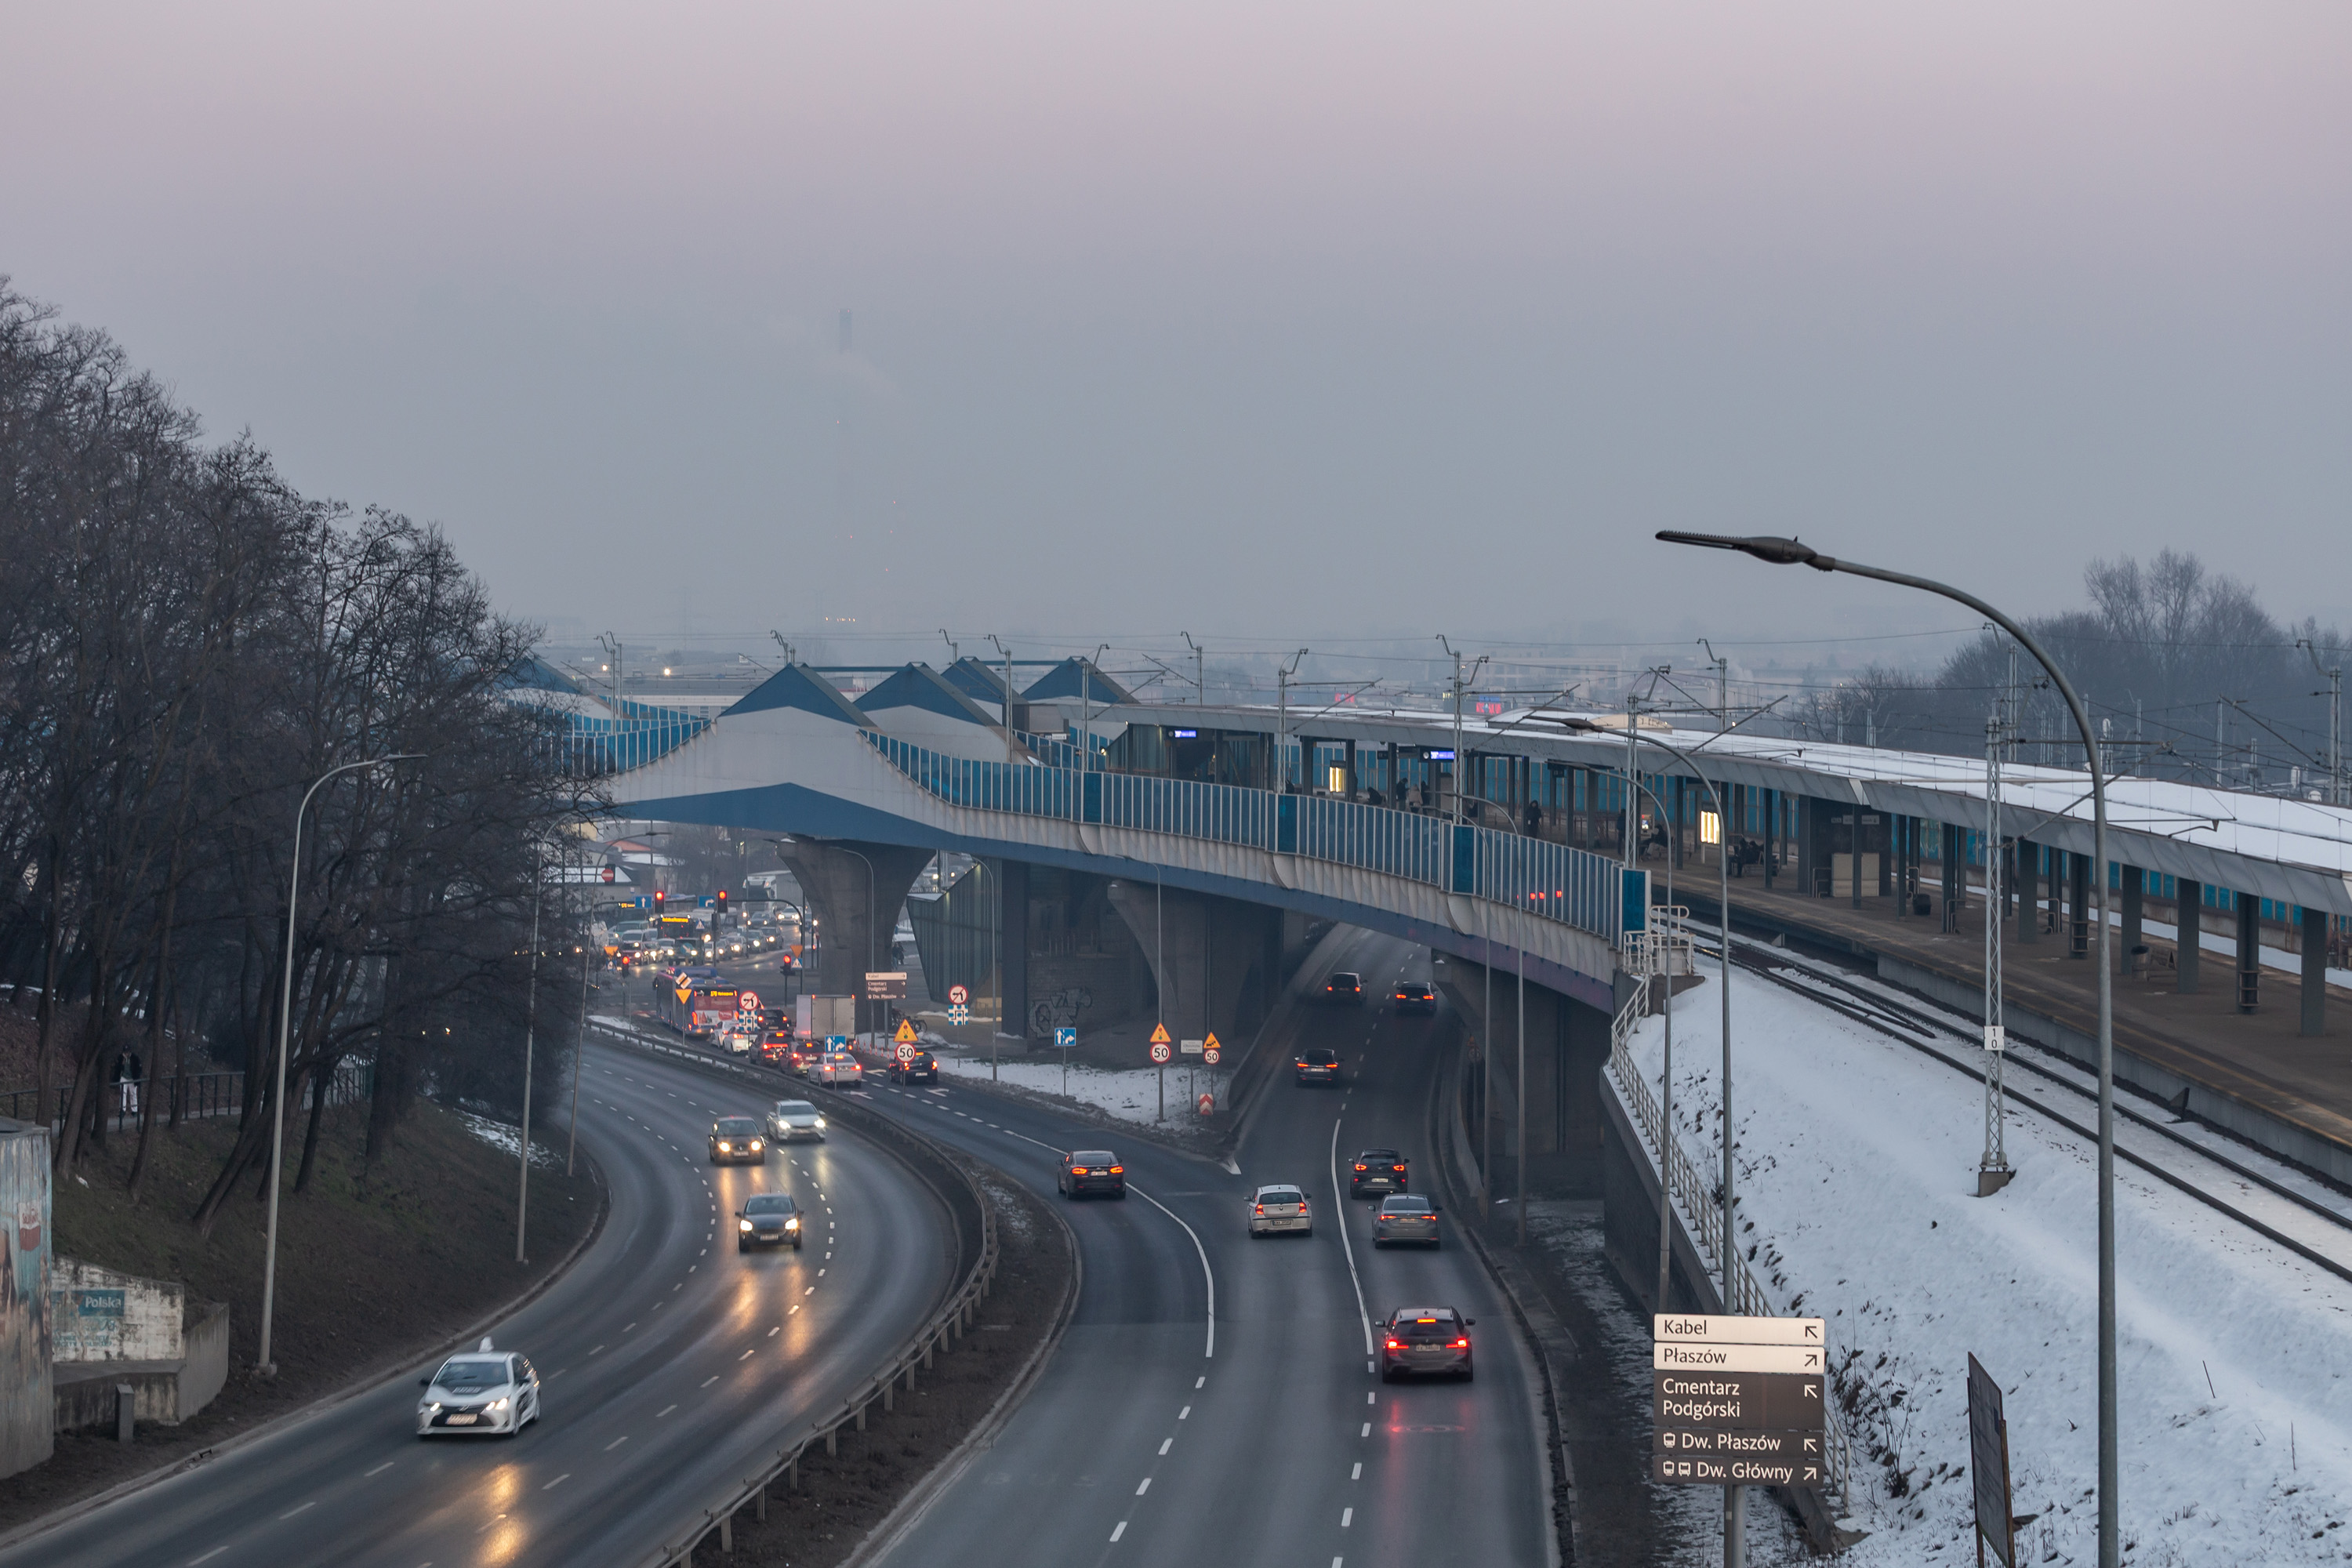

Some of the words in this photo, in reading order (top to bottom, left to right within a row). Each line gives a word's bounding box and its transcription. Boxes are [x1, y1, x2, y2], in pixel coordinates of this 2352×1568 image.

[1992, 1028, 1996, 1037] 1
[1991, 1039, 1997, 1048] 0
[899, 1047, 913, 1058] 50
[1154, 1047, 1168, 1058] 50
[1207, 1052, 1218, 1061] 50
[85, 1295, 122, 1308] Polska
[1664, 1319, 1708, 1335] Kabel
[1664, 1348, 1727, 1364] Płaszów
[1663, 1377, 1740, 1396] Cmentarz
[1663, 1399, 1740, 1421] Podgórski
[1682, 1433, 1711, 1449] Dw.
[1718, 1433, 1780, 1451] Płaszów
[1697, 1461, 1726, 1478] Dw.
[1732, 1462, 1793, 1483] Główny
